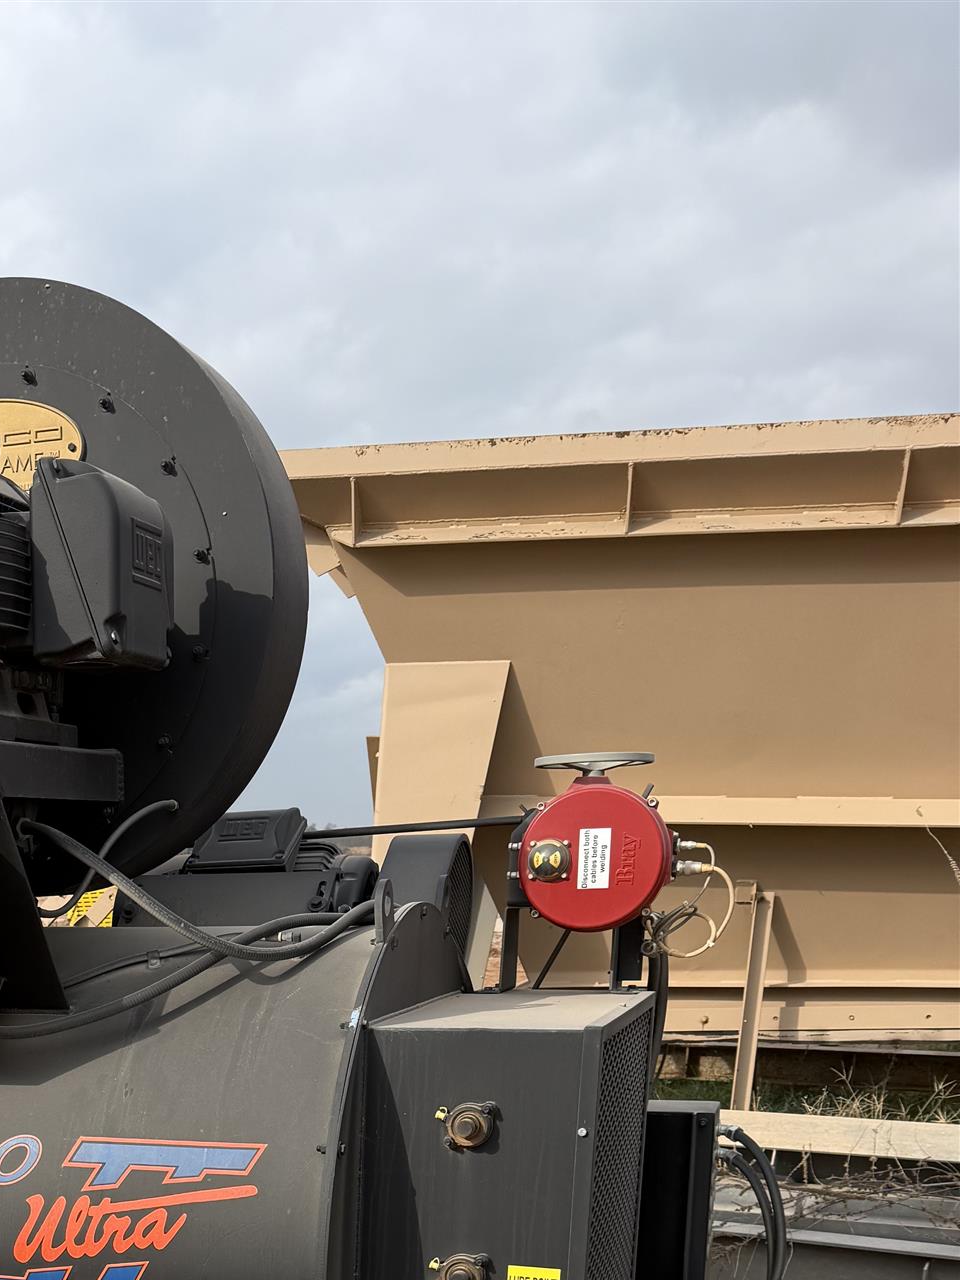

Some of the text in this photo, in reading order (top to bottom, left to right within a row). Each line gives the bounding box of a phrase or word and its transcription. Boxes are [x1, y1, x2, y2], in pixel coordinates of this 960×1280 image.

[581, 829, 591, 889] Disconnect both
[590, 834, 599, 884] cables before
[599, 844, 608, 873] welding
[614, 831, 642, 886] Bray
[13, 1184, 258, 1263] Ultra
